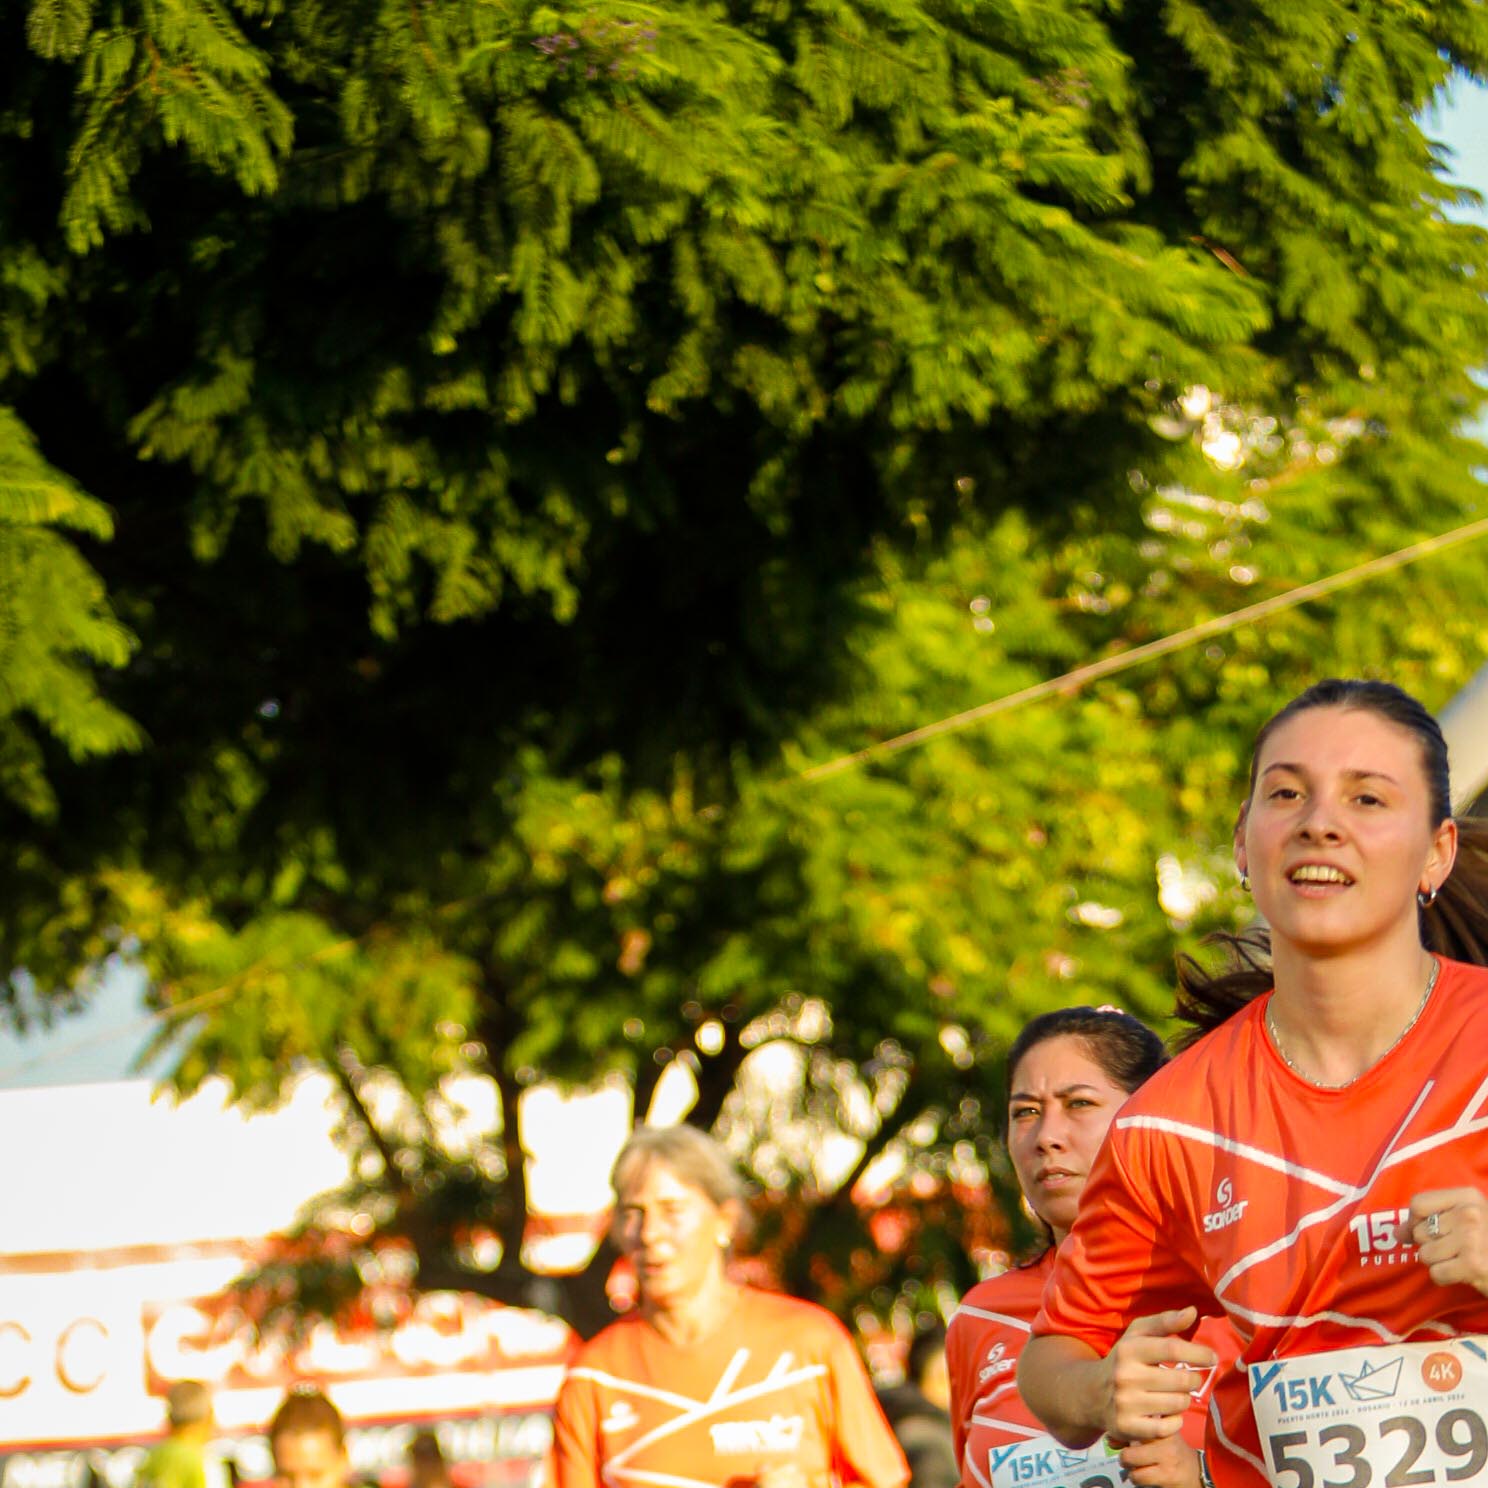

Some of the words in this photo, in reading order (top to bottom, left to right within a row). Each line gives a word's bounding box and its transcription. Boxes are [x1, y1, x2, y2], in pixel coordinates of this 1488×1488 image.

[1360, 1252, 1420, 1267] PUERT
[1429, 1363, 1455, 1380] 4K
[1273, 1375, 1336, 1412] 15K
[1008, 1450, 1054, 1481] 15K
